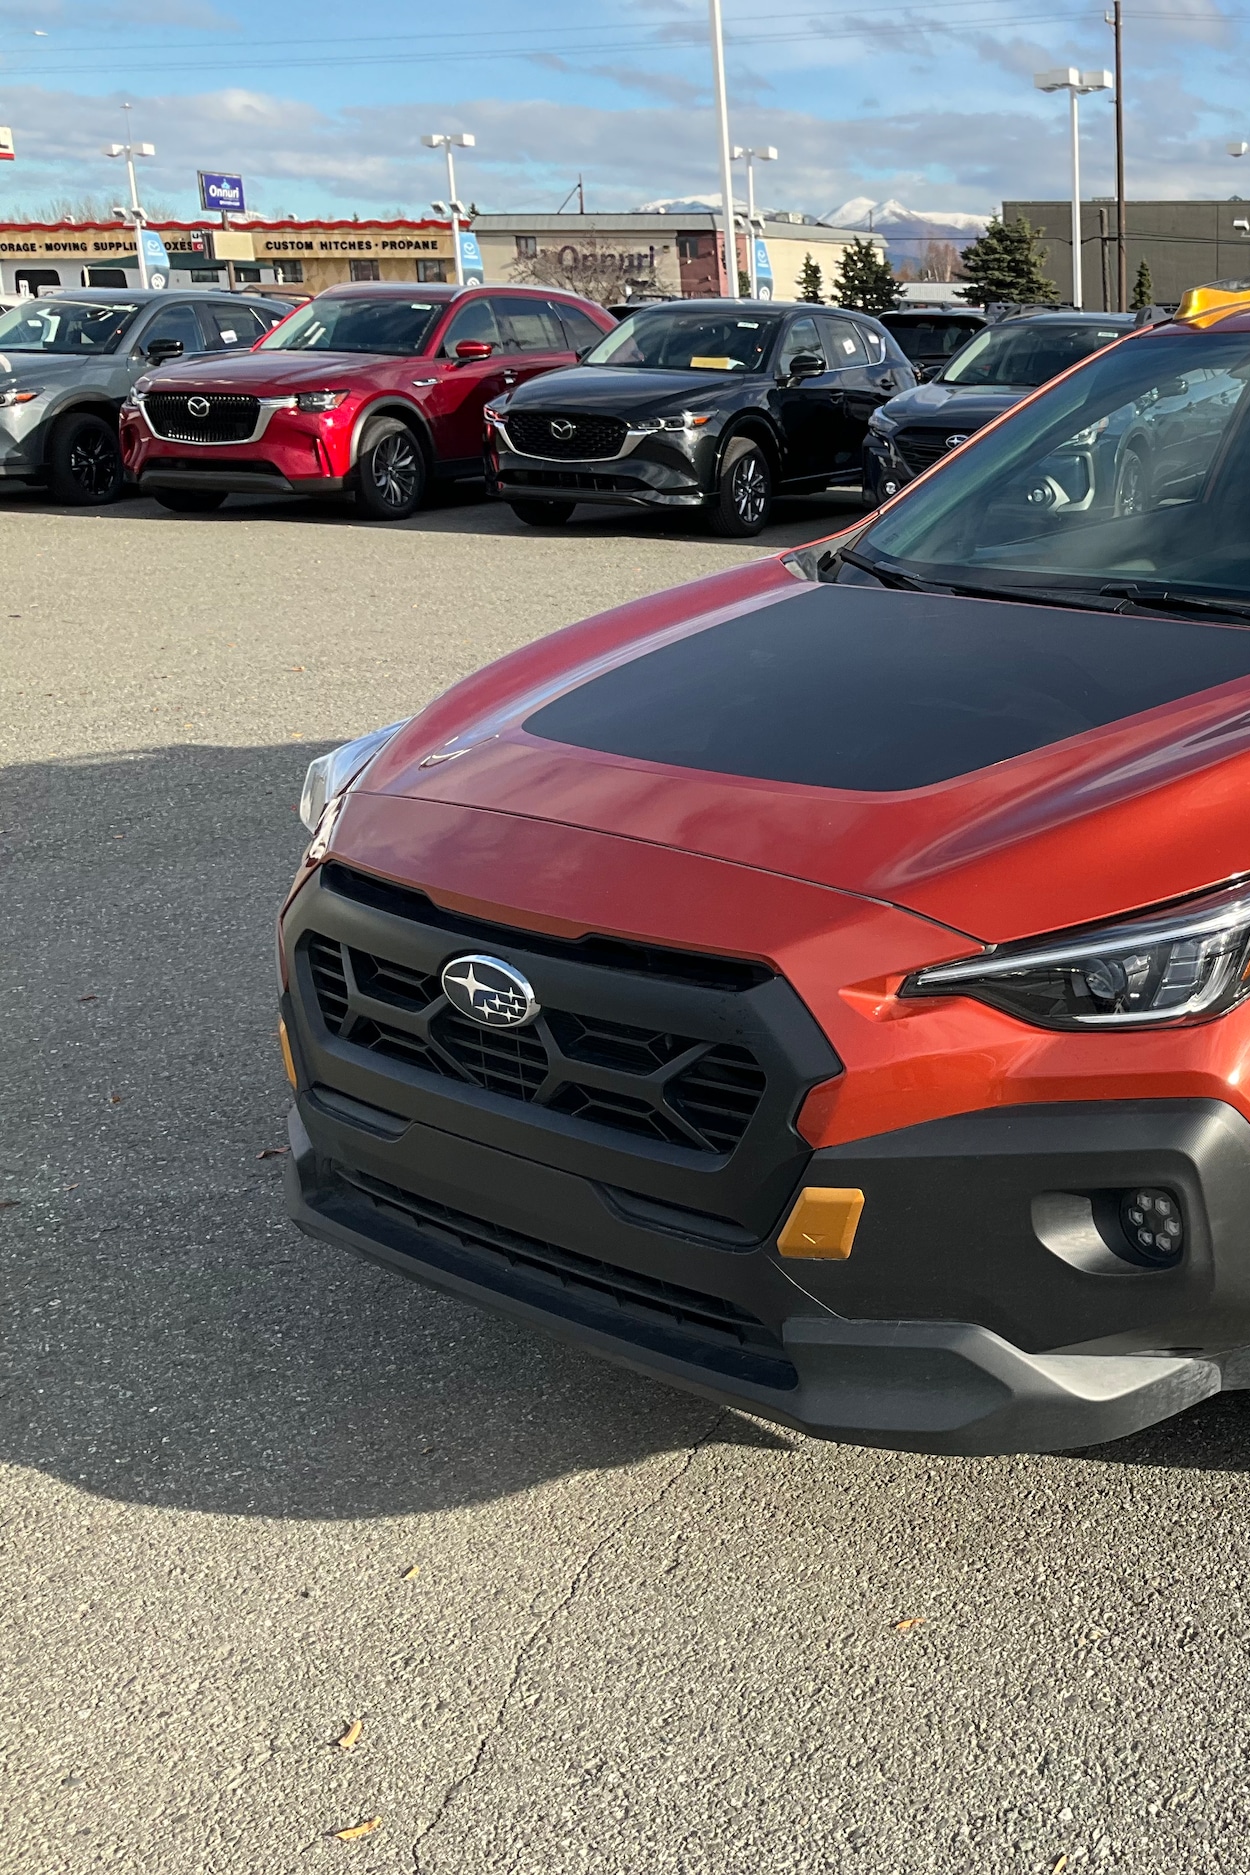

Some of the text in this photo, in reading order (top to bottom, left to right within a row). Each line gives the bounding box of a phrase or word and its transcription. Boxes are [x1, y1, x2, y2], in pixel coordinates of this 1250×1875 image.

[208, 184, 240, 199] Onnuri
[45, 242, 88, 252] MOVING
[165, 241, 192, 251] OXES
[265, 240, 439, 250] CUSTOM HITCHES PROPANE
